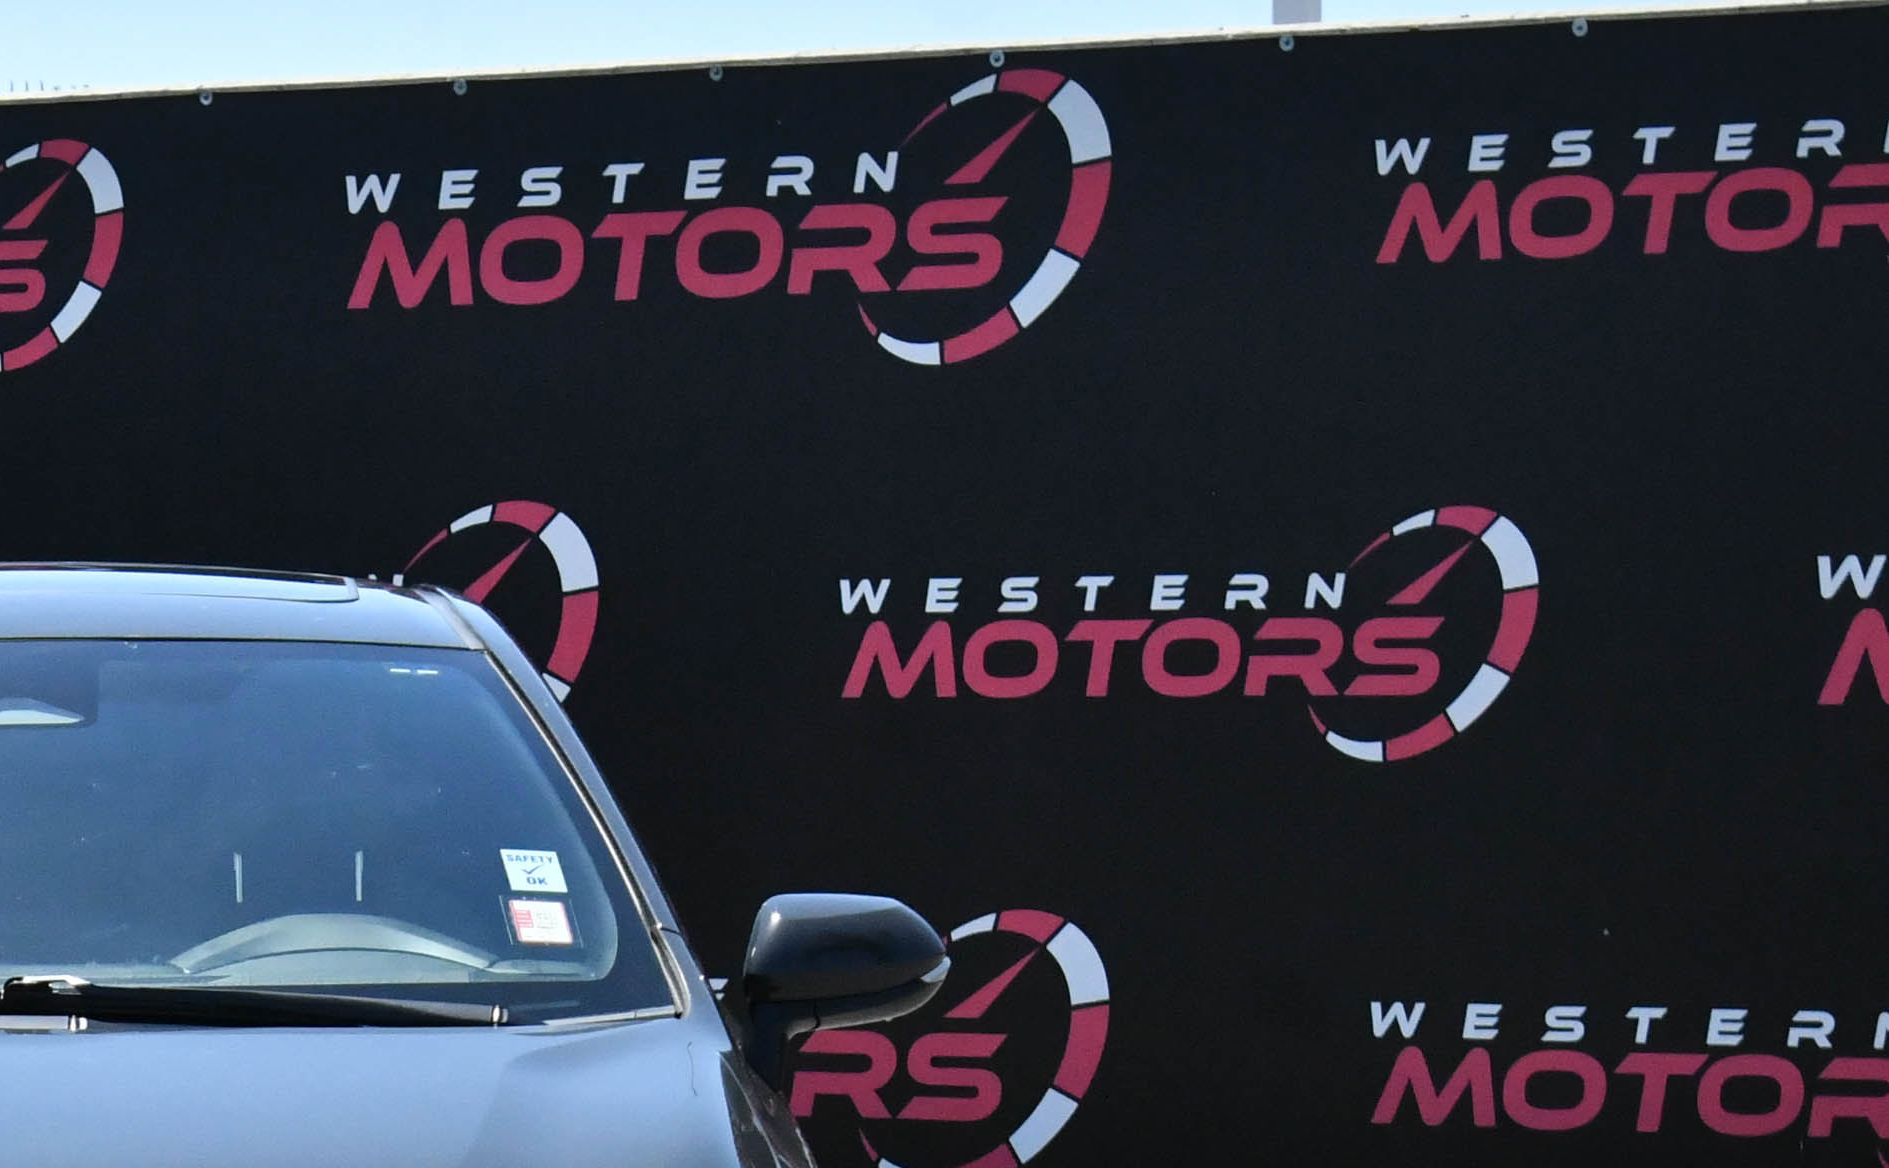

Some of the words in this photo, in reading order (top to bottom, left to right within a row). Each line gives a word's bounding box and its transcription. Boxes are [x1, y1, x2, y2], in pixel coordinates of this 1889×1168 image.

[1376, 120, 1889, 175] WESTER
[346, 152, 898, 214] WESTERN
[349, 197, 1009, 310] MOTORS
[840, 573, 1345, 614] WESTERN
[844, 616, 1442, 698] MOTORS
[506, 854, 553, 864] SAFETY
[526, 876, 548, 886] OK
